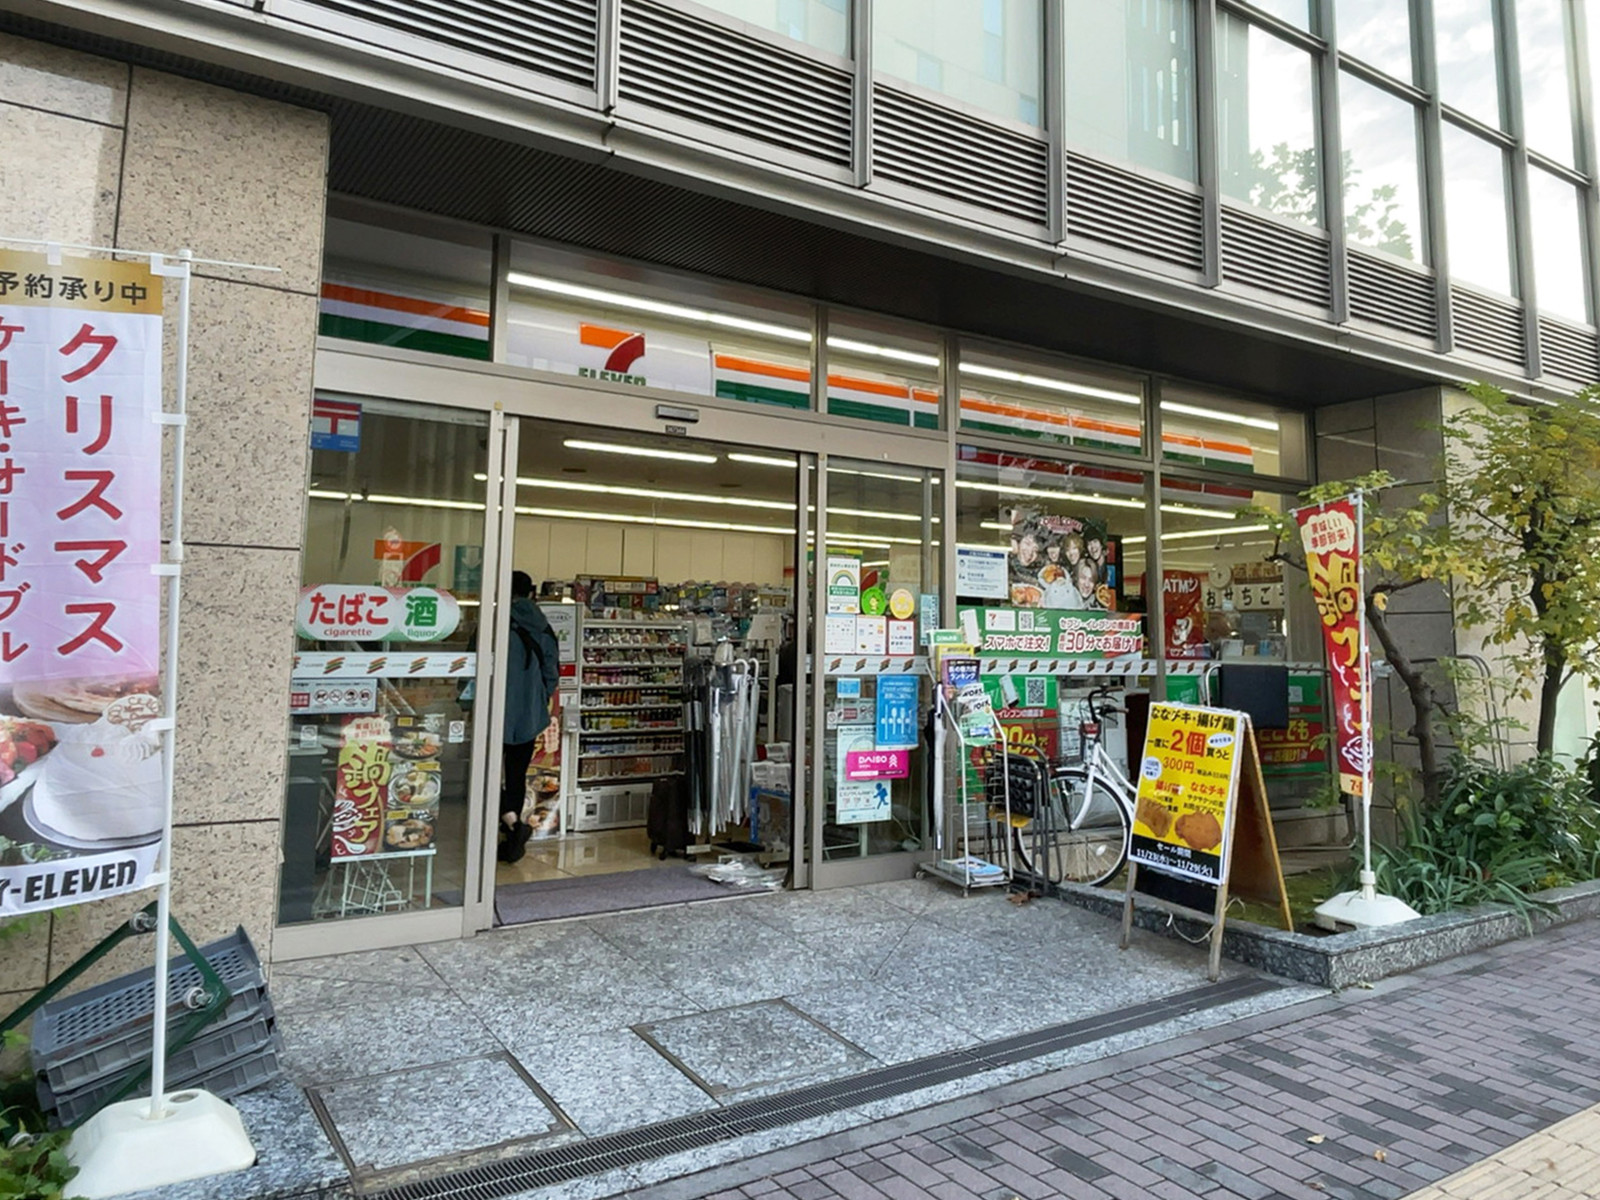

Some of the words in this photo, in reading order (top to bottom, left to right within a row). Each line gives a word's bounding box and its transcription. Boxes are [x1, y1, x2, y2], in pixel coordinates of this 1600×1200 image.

[54, 323, 128, 656] クリスマス
[309, 592, 389, 626] たばこ
[405, 595, 438, 627] 酒
[324, 628, 373, 637] cigarette
[407, 629, 438, 639] liquor
[985, 636, 1050, 651] スマホで注文!
[858, 755, 887, 764] DAISO
[1162, 757, 1195, 774] 300円
[1190, 782, 1226, 797] ななチキ
